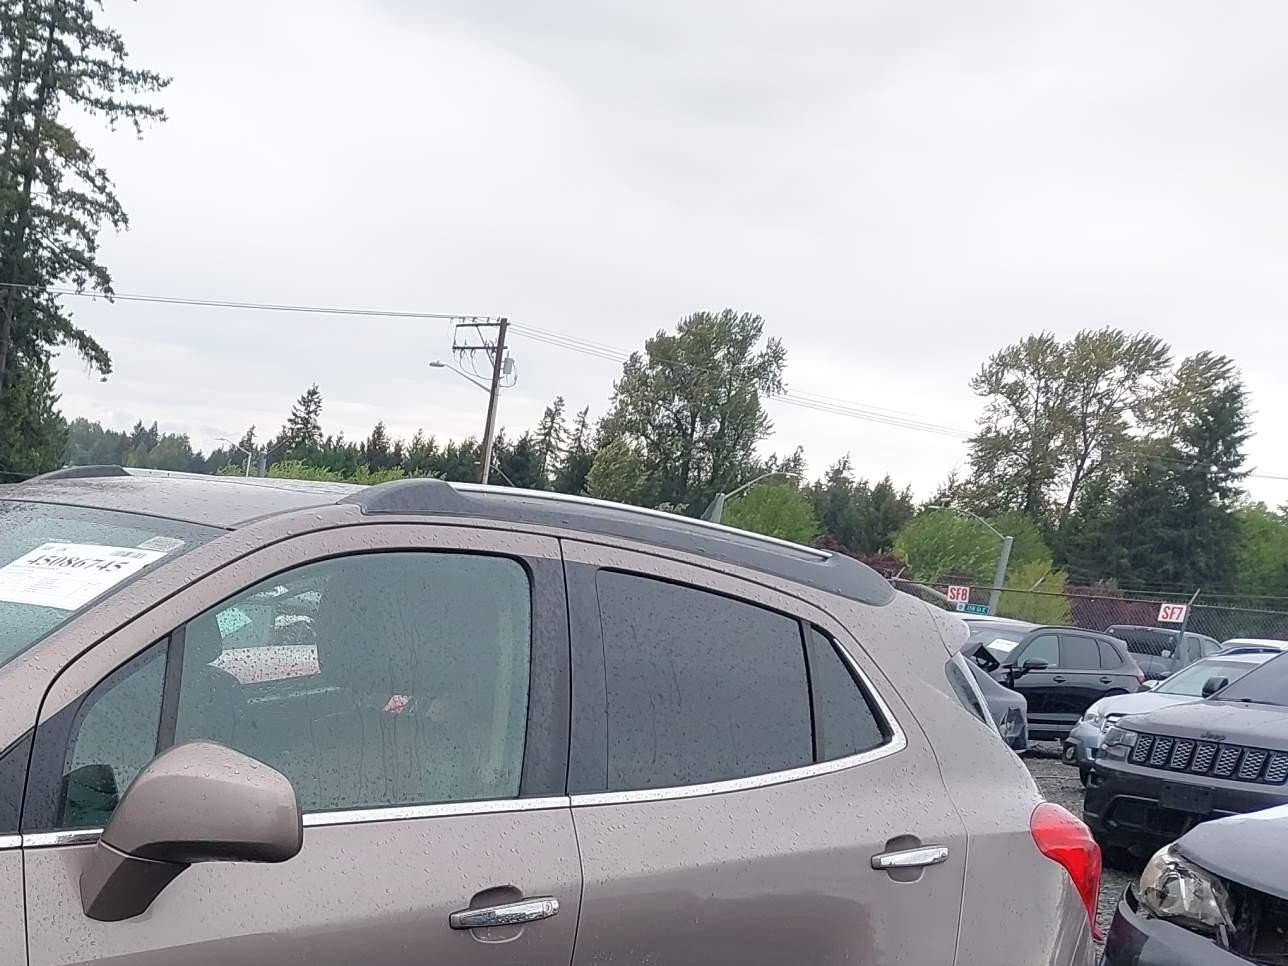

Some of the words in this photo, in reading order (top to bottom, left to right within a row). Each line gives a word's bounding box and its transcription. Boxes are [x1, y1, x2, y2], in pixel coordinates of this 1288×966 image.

[27, 554, 129, 572] 45086745
[949, 587, 968, 601] SF8
[1161, 606, 1184, 620] SF7
